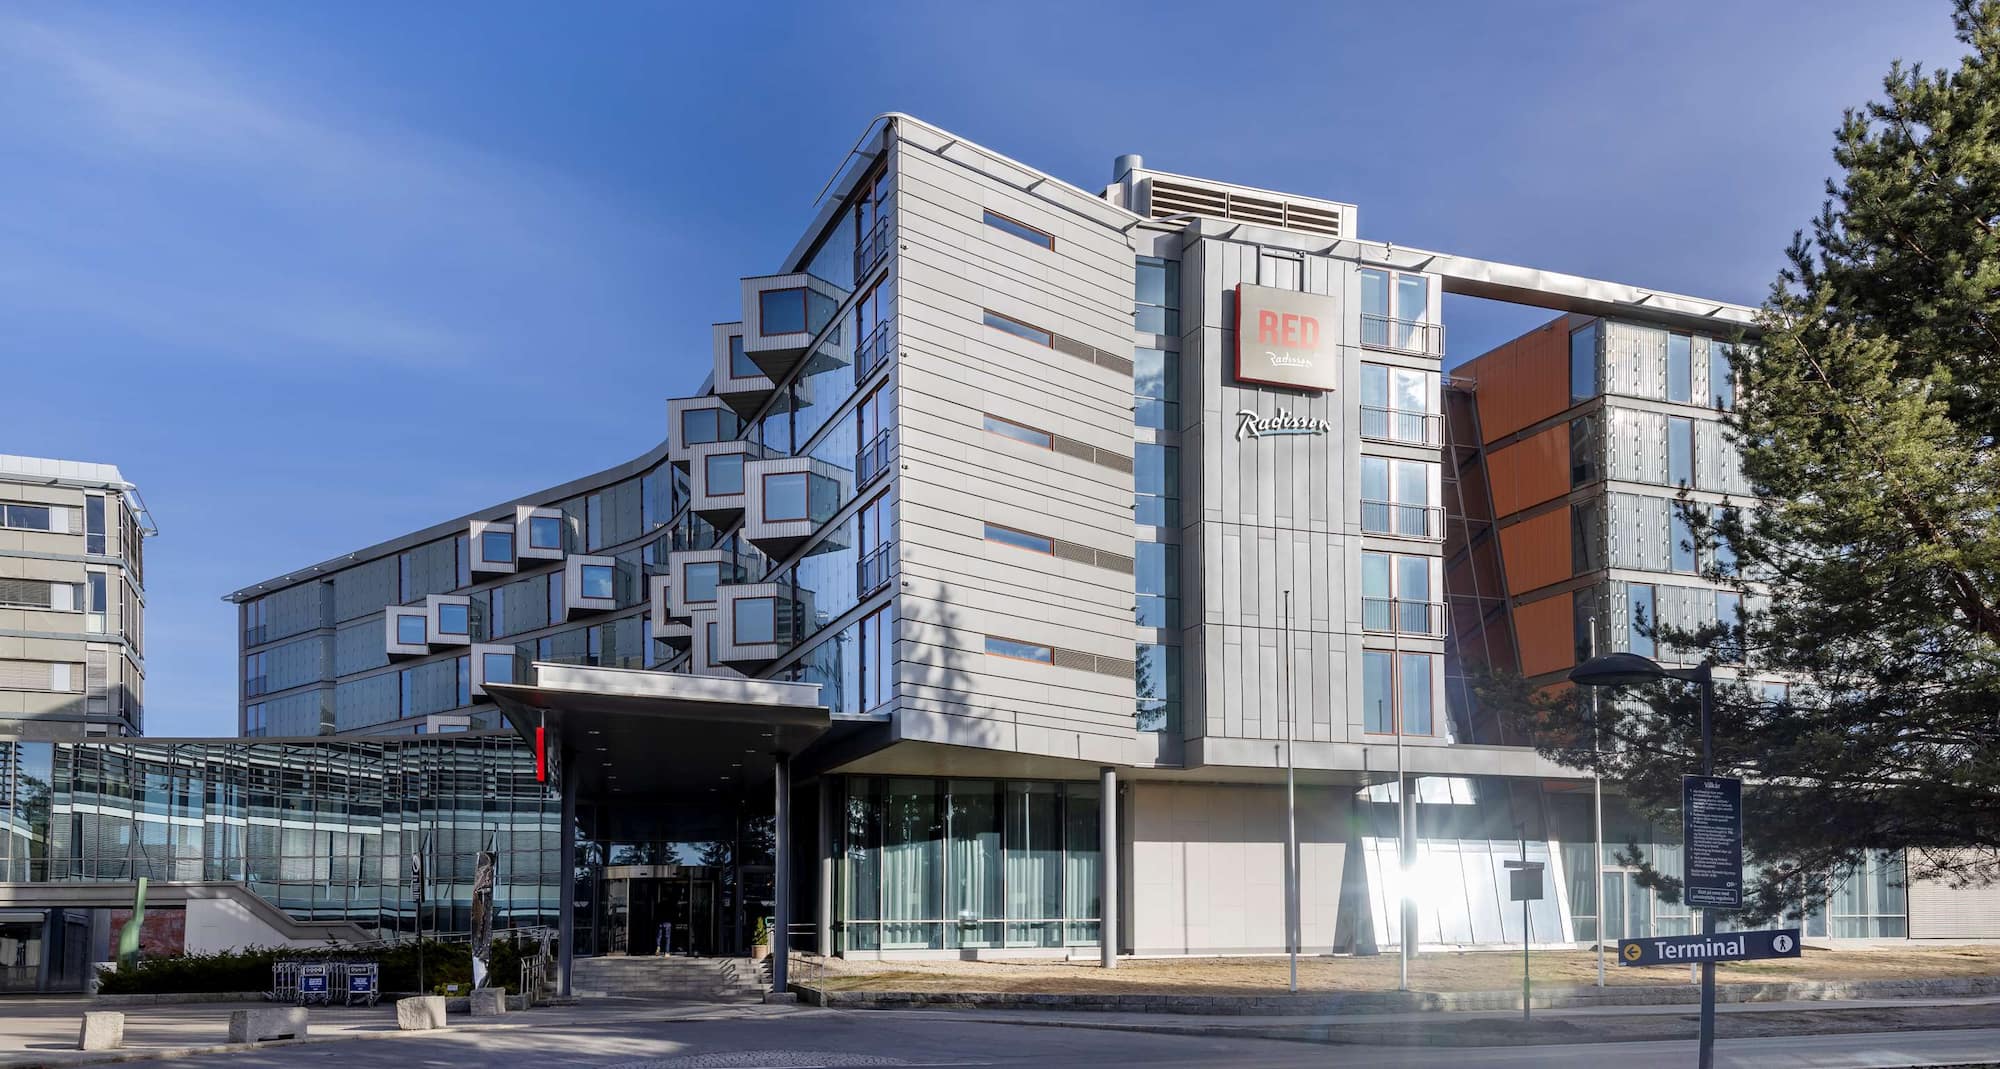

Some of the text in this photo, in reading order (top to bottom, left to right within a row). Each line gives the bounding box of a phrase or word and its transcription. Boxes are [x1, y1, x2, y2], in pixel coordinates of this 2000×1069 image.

[1259, 311, 1319, 349] RED
[1266, 352, 1312, 368] Radisson
[1237, 408, 1331, 442] Radisson
[1655, 936, 1745, 959] Terminal
